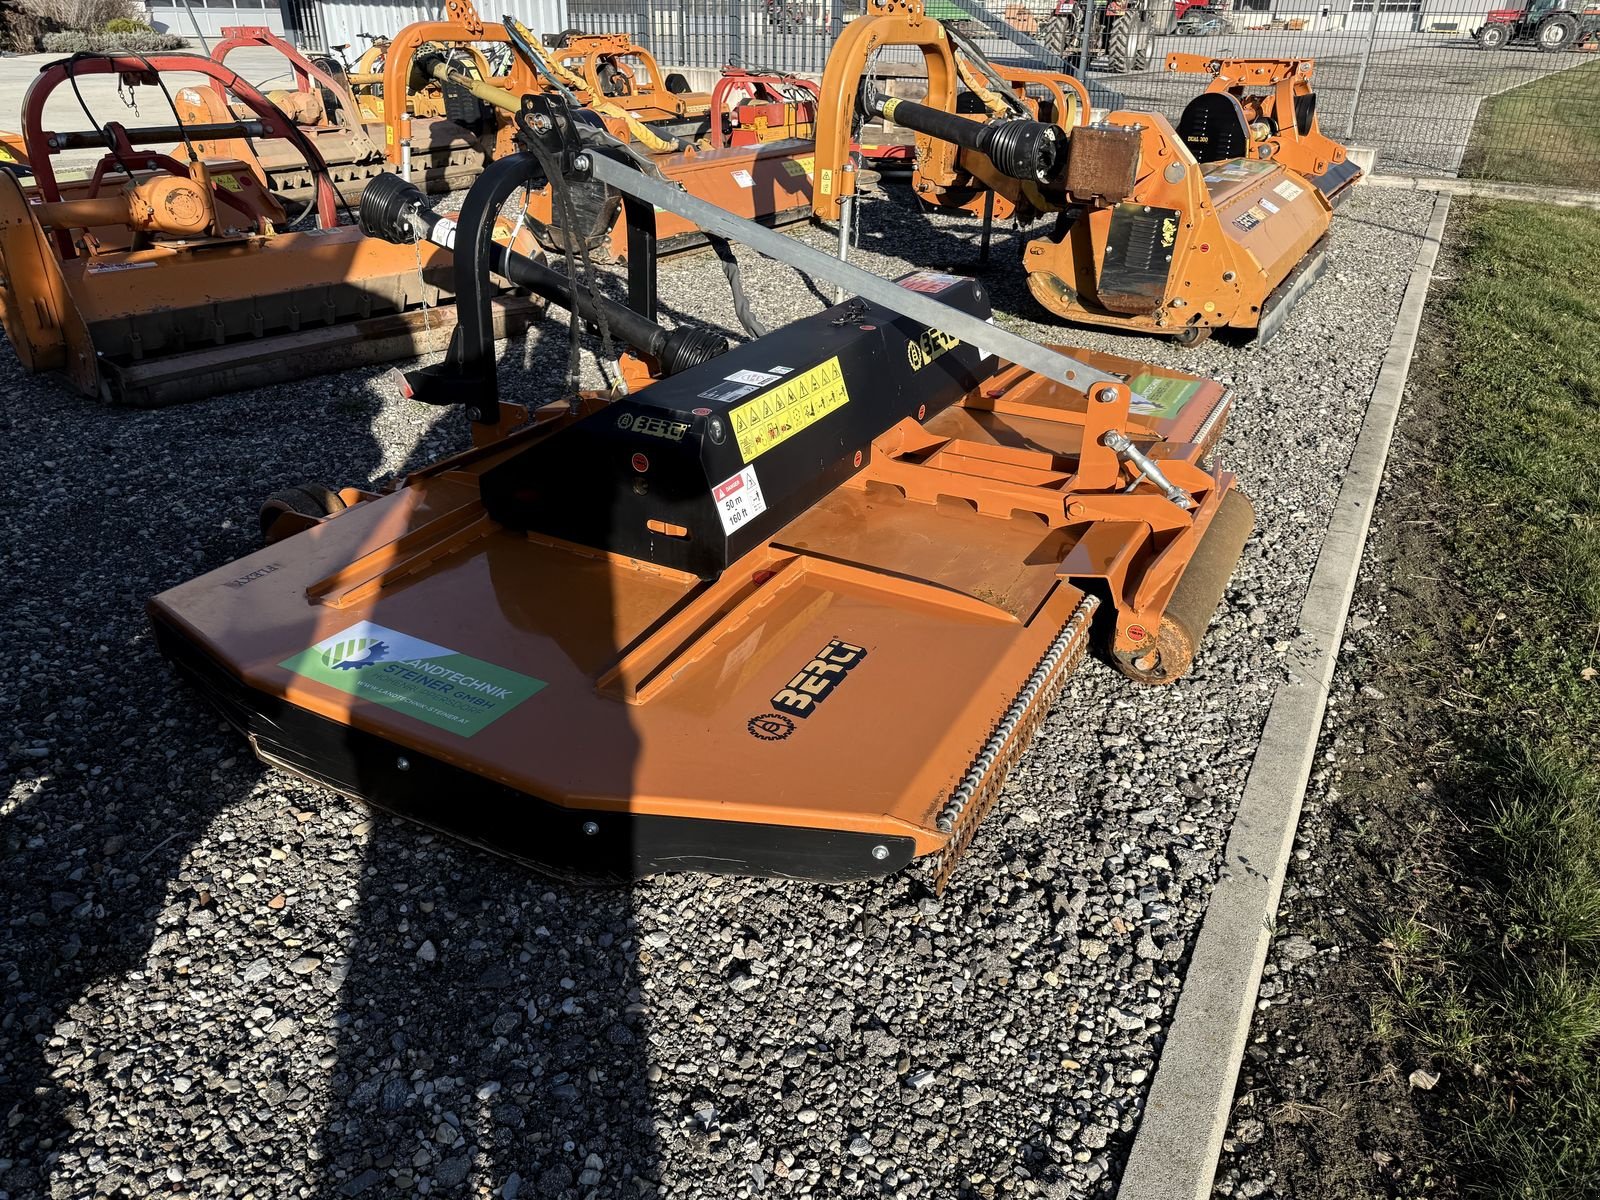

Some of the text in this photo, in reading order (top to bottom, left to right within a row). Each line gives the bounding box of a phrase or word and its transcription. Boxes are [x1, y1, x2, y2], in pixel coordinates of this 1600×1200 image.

[725, 496, 742, 511] 50 m
[729, 508, 748, 525] 160 ft
[383, 664, 496, 710] STEINER GMBH
[399, 657, 512, 700] LANDTECHNIK
[770, 639, 868, 719] BERTI
